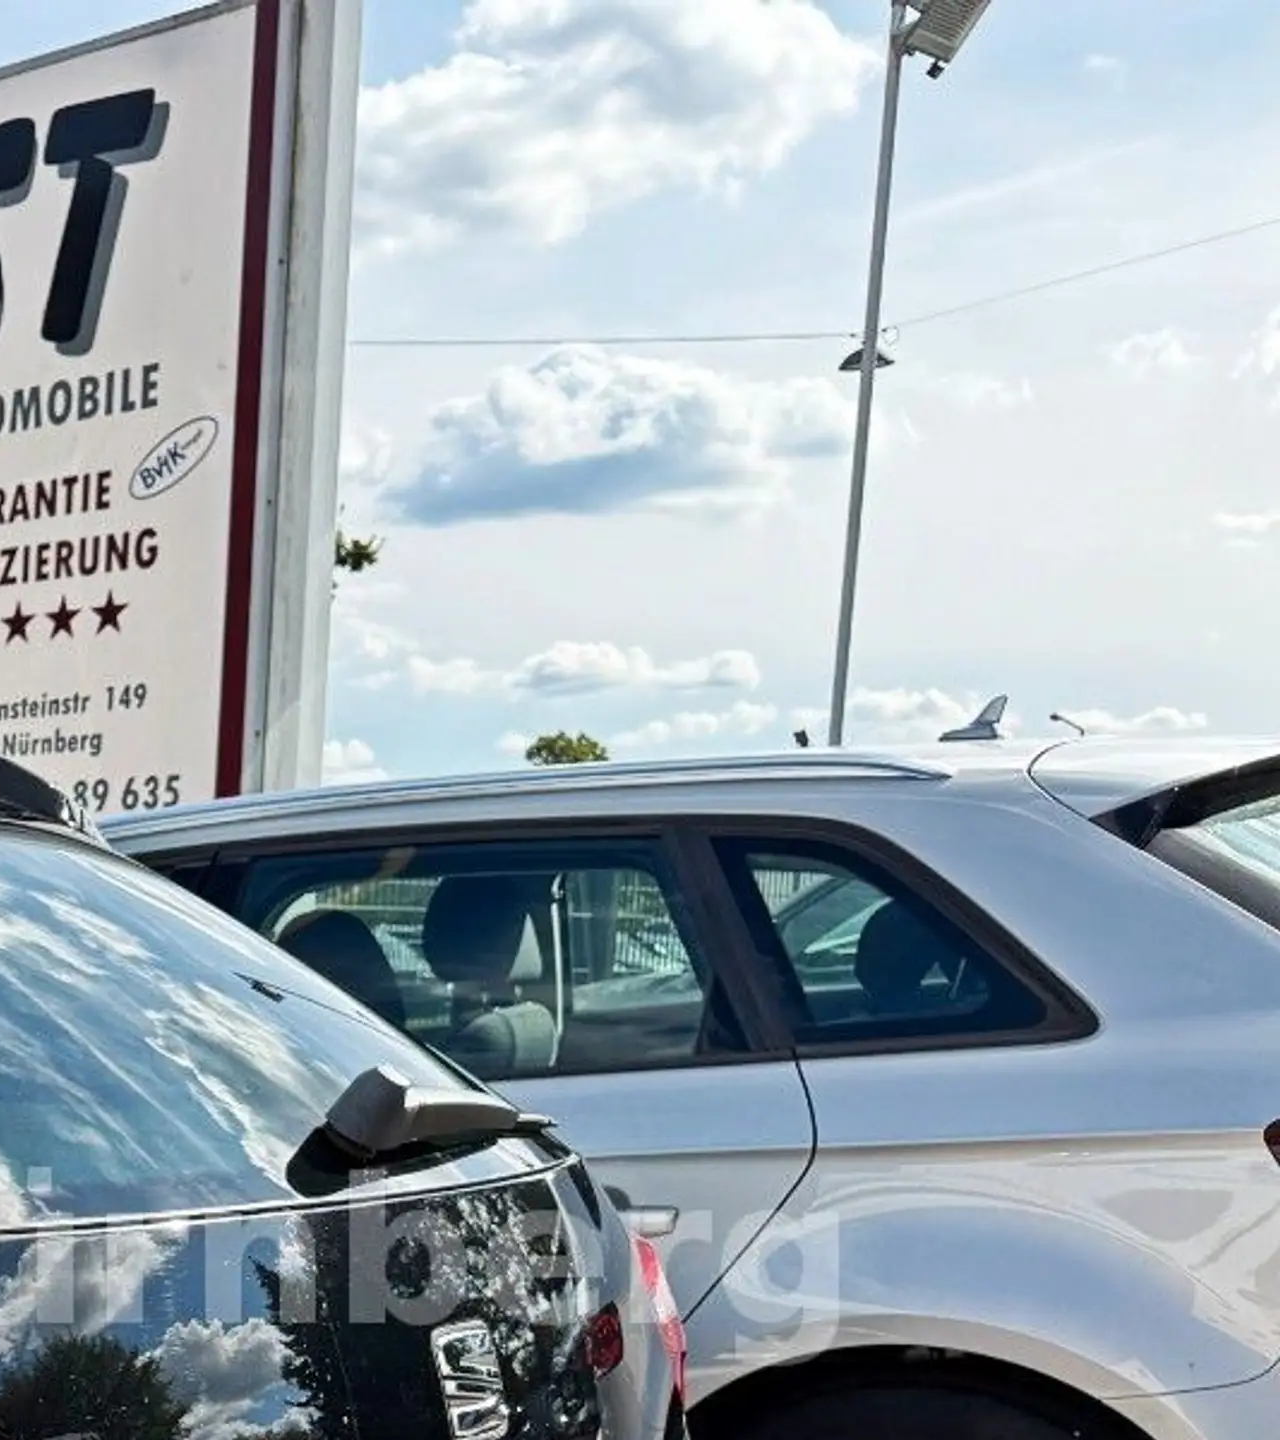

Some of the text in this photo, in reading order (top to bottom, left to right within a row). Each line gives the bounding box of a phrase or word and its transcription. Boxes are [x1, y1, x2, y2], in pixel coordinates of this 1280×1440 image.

[105, 683, 148, 711] 149
[2, 729, 103, 757] Nürnberg
[121, 774, 180, 810] 635
